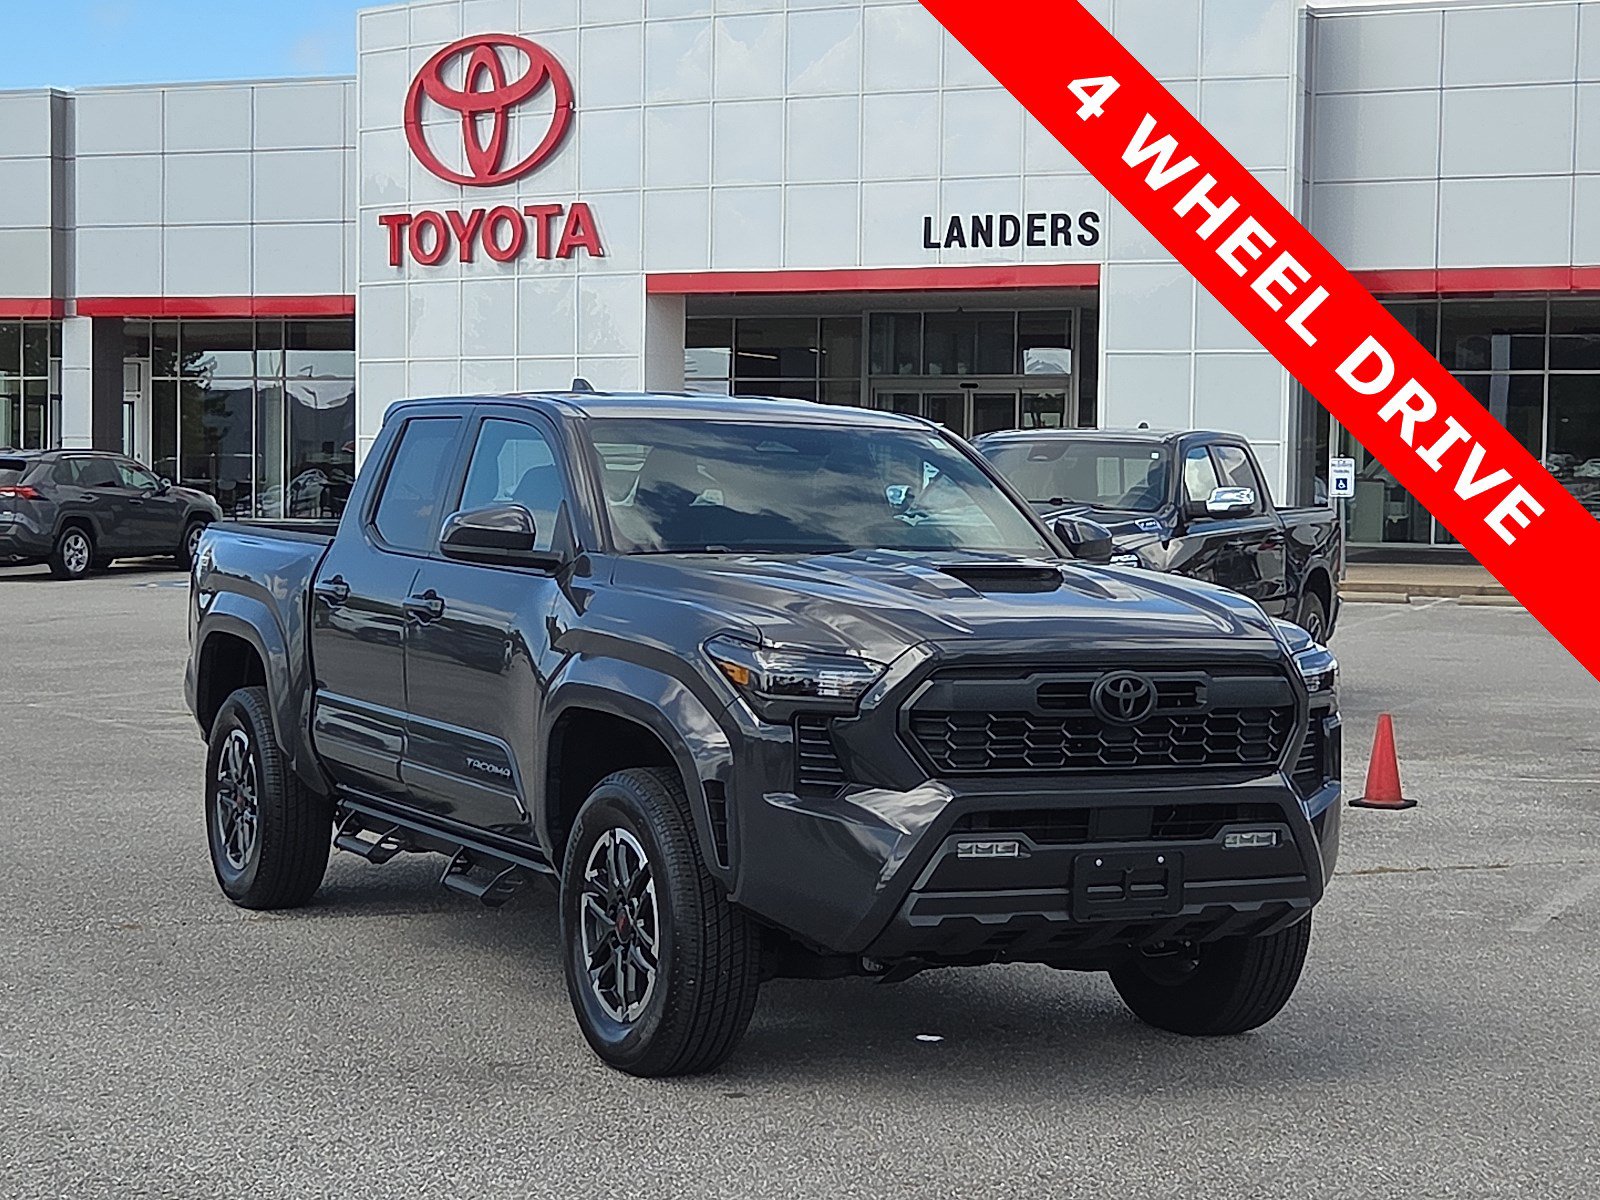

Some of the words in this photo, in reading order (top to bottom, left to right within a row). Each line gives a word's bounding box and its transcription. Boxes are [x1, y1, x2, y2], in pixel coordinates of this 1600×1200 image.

[379, 203, 604, 266] TOYOTA
[923, 211, 1100, 249] LANDERS
[466, 757, 511, 777] TACOMA
